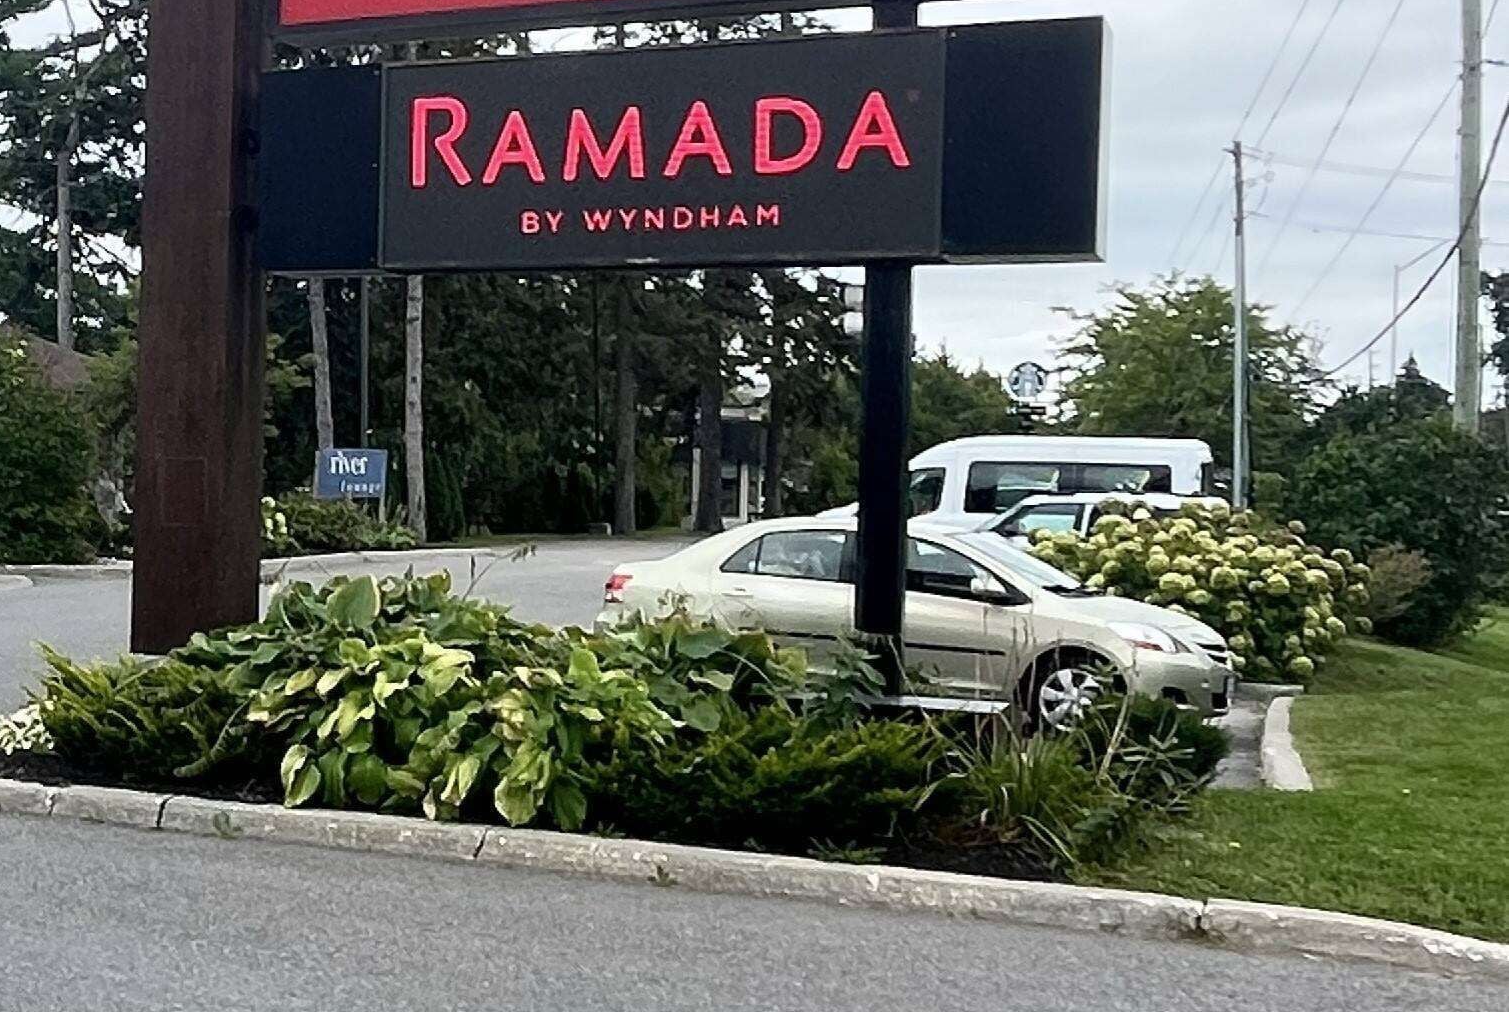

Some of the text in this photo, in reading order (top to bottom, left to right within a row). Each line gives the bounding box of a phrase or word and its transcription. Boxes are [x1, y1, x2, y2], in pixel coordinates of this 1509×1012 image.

[411, 90, 911, 188] RAMADA
[521, 204, 781, 234] BY WYNDHAM
